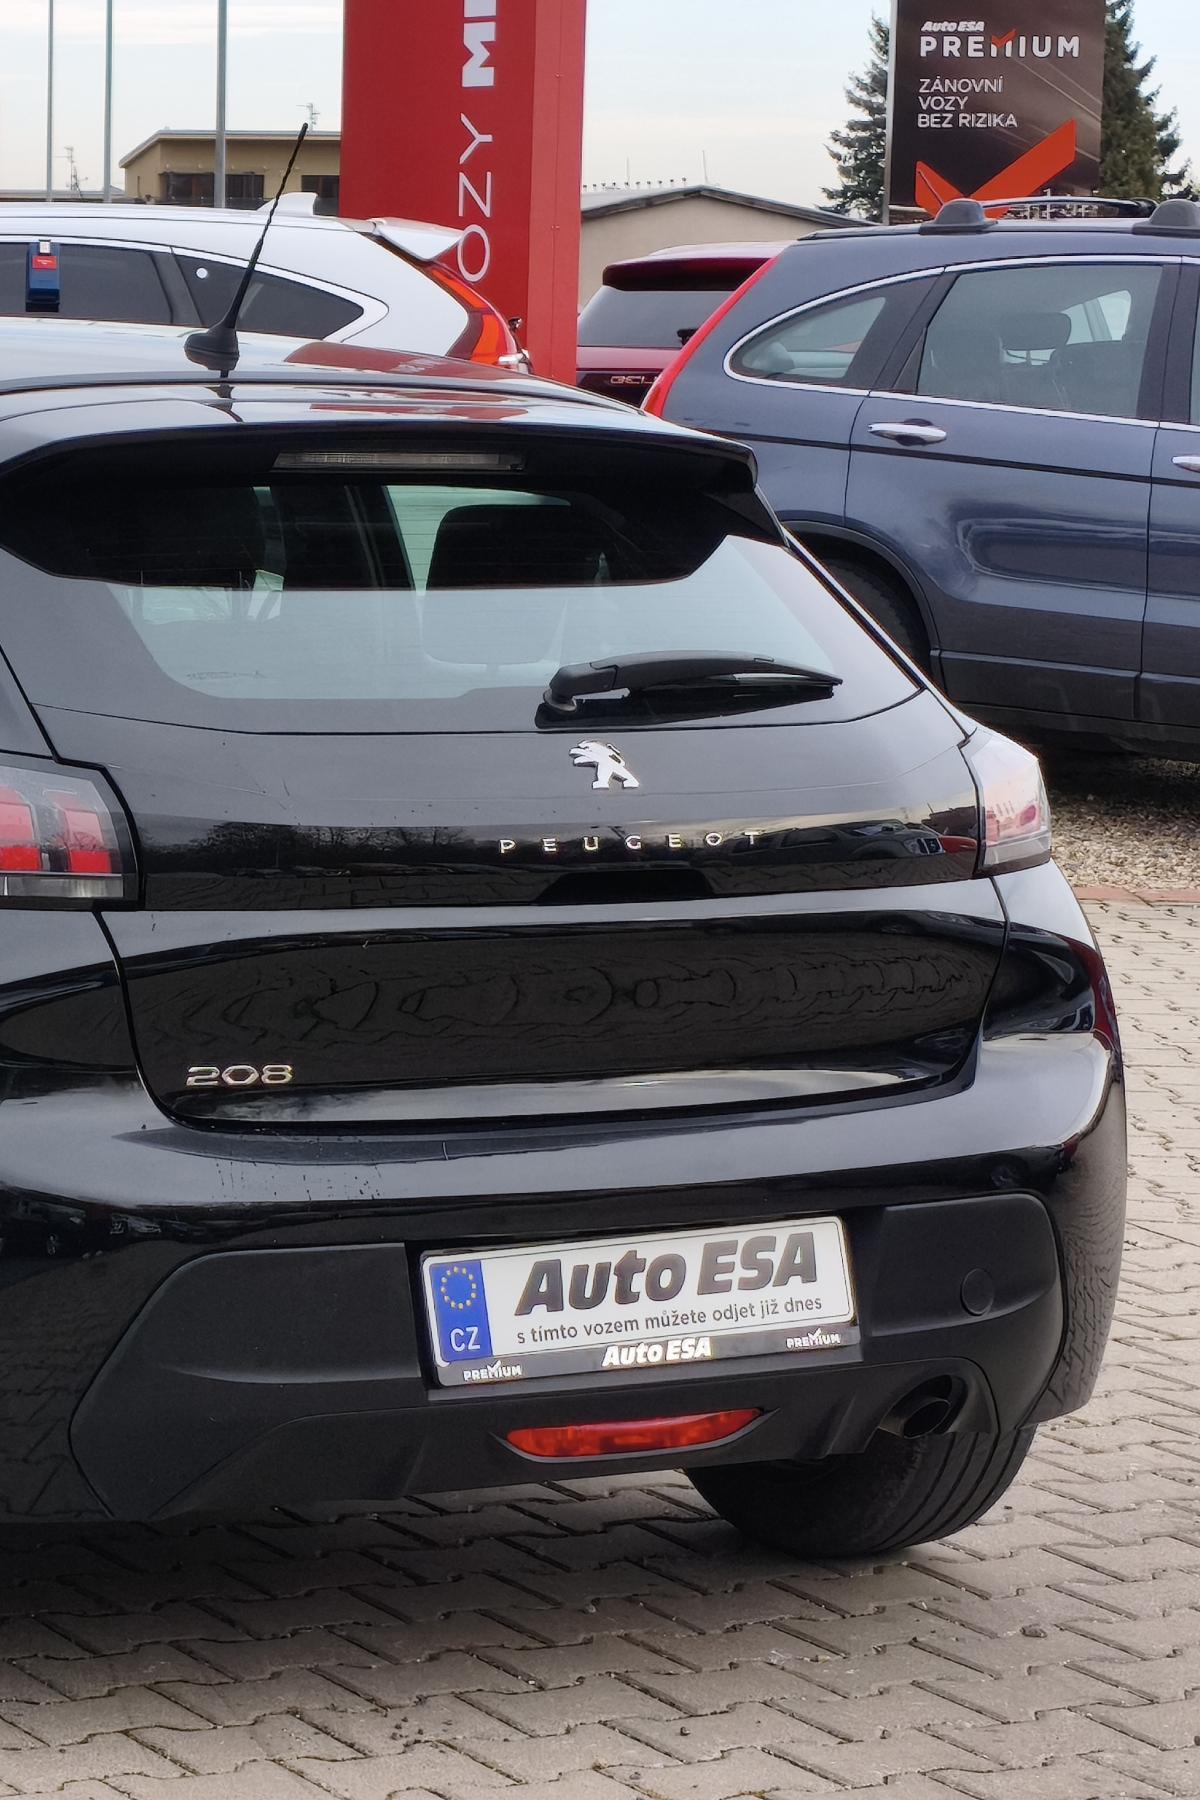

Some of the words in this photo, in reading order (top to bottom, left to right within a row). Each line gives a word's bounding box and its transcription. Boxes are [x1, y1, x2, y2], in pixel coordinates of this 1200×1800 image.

[920, 21, 956, 32] Auto
[957, 21, 985, 32] ESA
[920, 32, 1080, 58] PREMIUM
[918, 76, 1004, 93] ZÁNOVNÍ
[918, 96, 969, 111] VOZY
[917, 113, 952, 128] BEZ
[958, 112, 1018, 128] RIZIKA
[457, 112, 493, 282] OZY
[499, 830, 762, 854] PEUGEOT
[186, 1064, 293, 1086] 208
[514, 1250, 687, 1316] Auto
[697, 1232, 818, 1295] ESA
[517, 1331, 526, 1344] s
[530, 1323, 578, 1342] tímto
[583, 1317, 639, 1336] vozem
[644, 1308, 707, 1329] můžete
[712, 1302, 755, 1324] odjet
[759, 1298, 780, 1319] již
[785, 1295, 823, 1314] dnes
[450, 1326, 481, 1352] CZ
[786, 1327, 841, 1349] PREMIUM
[601, 1340, 660, 1368] Auto
[665, 1337, 712, 1360] ESA
[463, 1360, 523, 1382] PREMIUM
